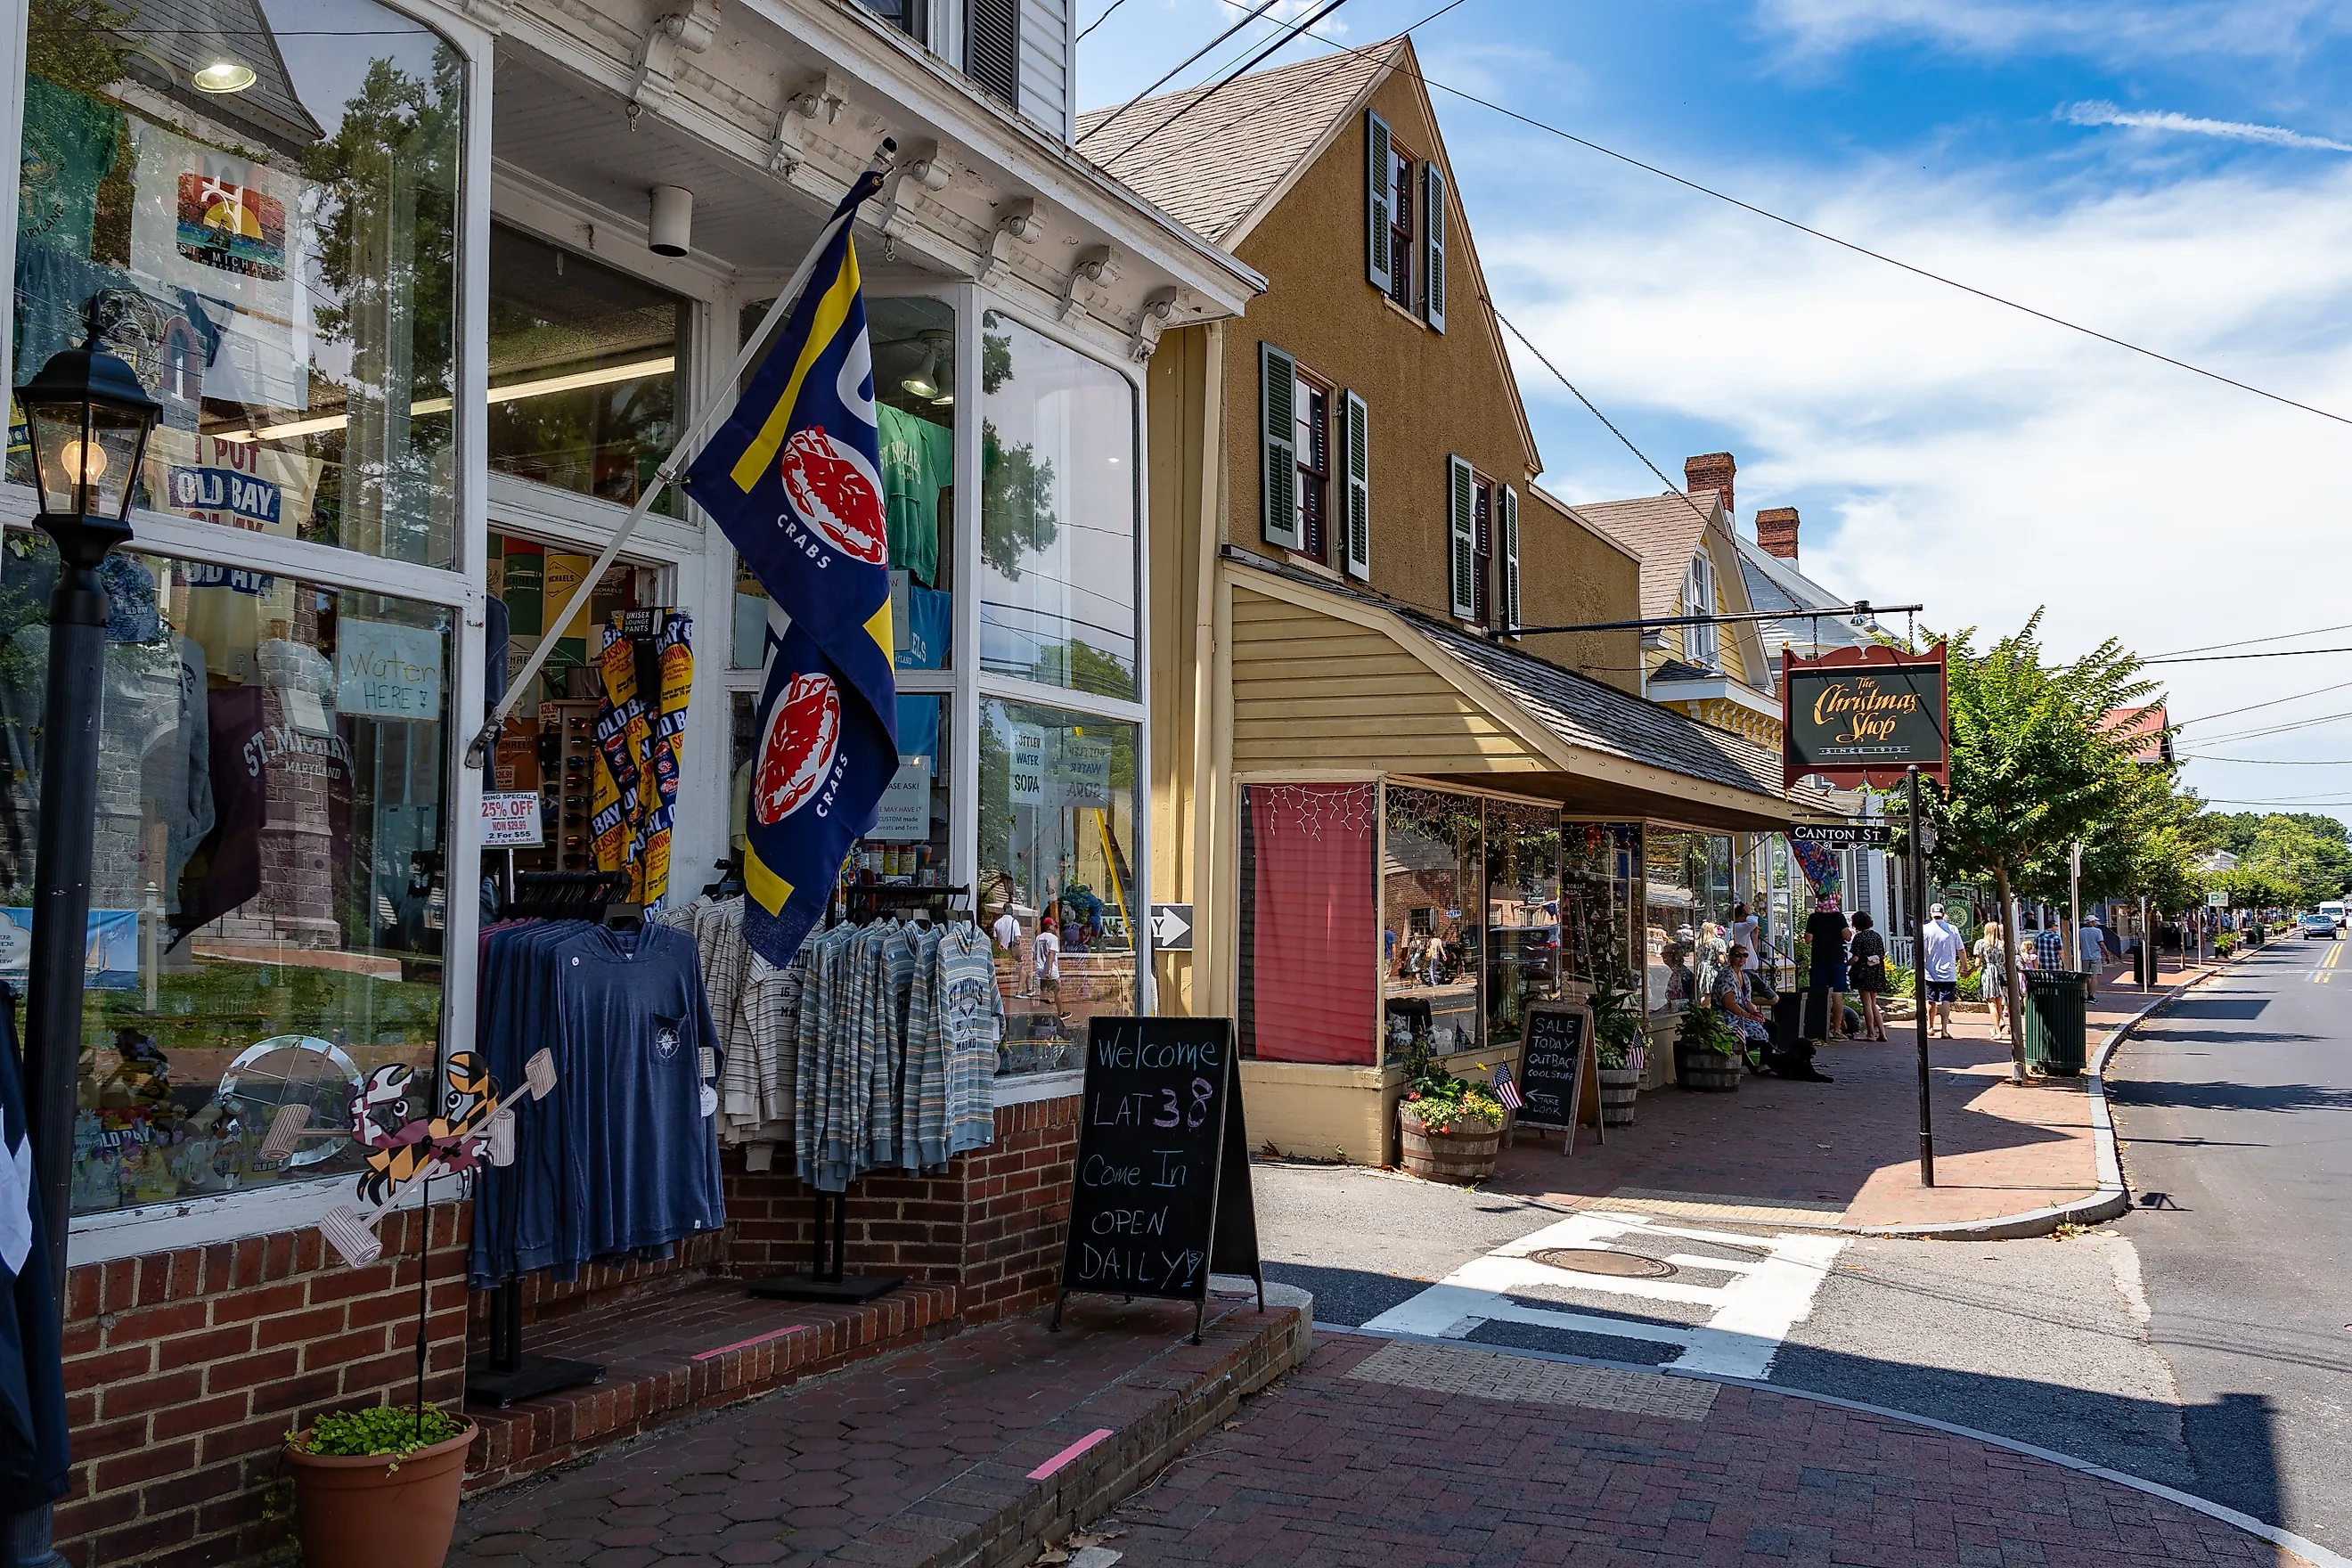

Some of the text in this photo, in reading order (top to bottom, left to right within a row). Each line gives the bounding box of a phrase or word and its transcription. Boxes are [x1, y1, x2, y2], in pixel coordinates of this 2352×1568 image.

[21, 203, 65, 239] ARYLAND
[213, 436, 261, 474] PUT
[177, 472, 224, 505] OLD
[777, 514, 831, 569] CRABS
[626, 611, 650, 620] UNISEX
[348, 650, 436, 682] Water
[1856, 676, 1876, 690] The
[1813, 682, 1922, 725] Christmas
[597, 707, 628, 740] OLD
[1835, 711, 1898, 743] Shop
[1016, 752, 1040, 766] WATER
[285, 762, 341, 780] MARYLAND
[816, 753, 848, 818] CRABS
[902, 782, 919, 790] ASK!
[1014, 773, 1041, 794] SODA
[481, 800, 534, 818] 25% OFF
[592, 803, 622, 836] BAY
[492, 820, 527, 831] NOW $29.99
[514, 830, 531, 838] $55
[1794, 826, 1884, 841] CANTON ST.
[1534, 1017, 1576, 1033] SALE
[1098, 1026, 1219, 1071] Welcome
[1532, 1035, 1575, 1050] TODAY
[1093, 1077, 1213, 1128] LAT 38
[1532, 1106, 1562, 1117] LOOK
[1538, 1097, 1561, 1106] TAKE
[99, 1131, 121, 1147] LD
[1082, 1149, 1187, 1188] Come In
[1091, 1205, 1169, 1235] OPEN
